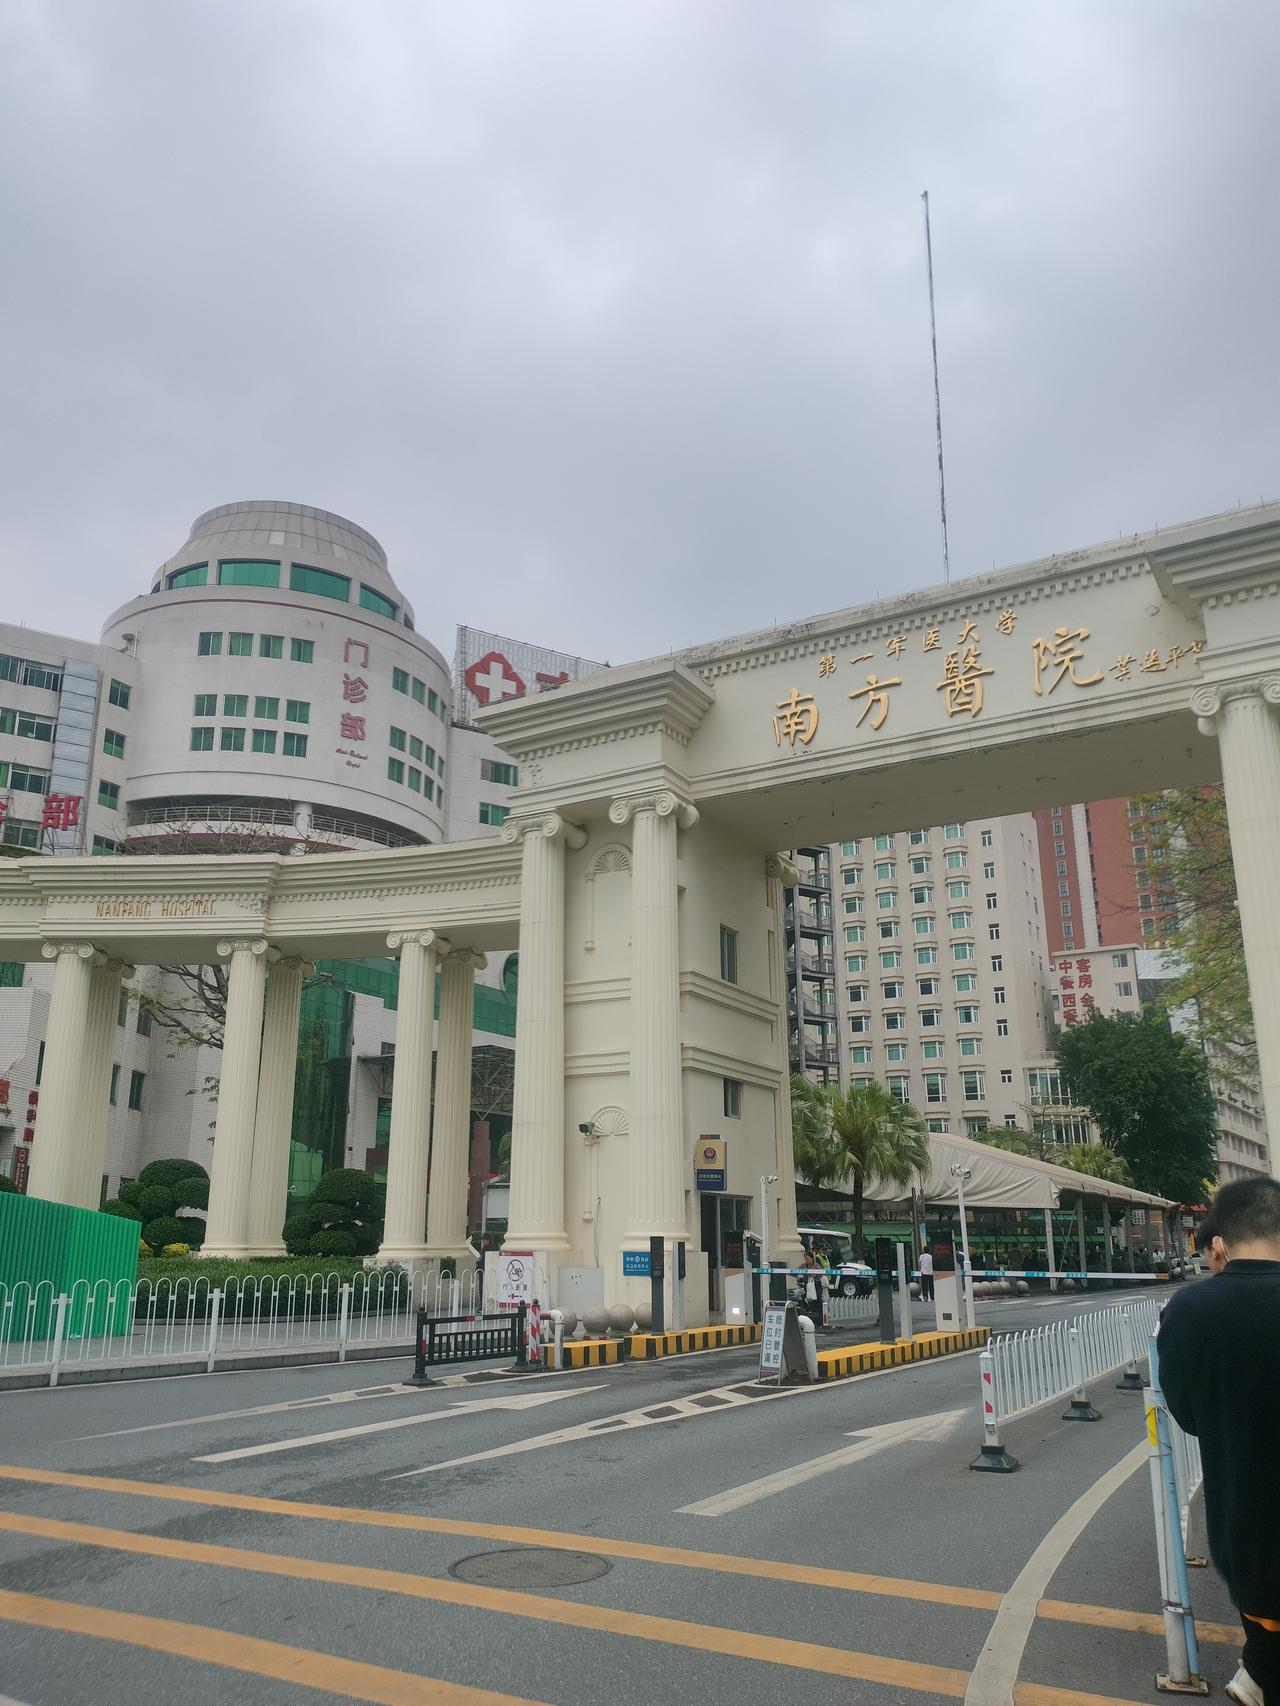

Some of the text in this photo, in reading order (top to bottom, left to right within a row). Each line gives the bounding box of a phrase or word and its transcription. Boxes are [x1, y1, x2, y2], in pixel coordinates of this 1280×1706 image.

[817, 608, 1018, 679] 第一军医大学
[341, 637, 369, 741] 门诊部
[771, 626, 1105, 747] 南方醫院
[96, 899, 216, 917] NANFANG HOSPITAL
[1059, 960, 1078, 1026] 中餐西餐
[764, 1314, 775, 1364] 车位已满
